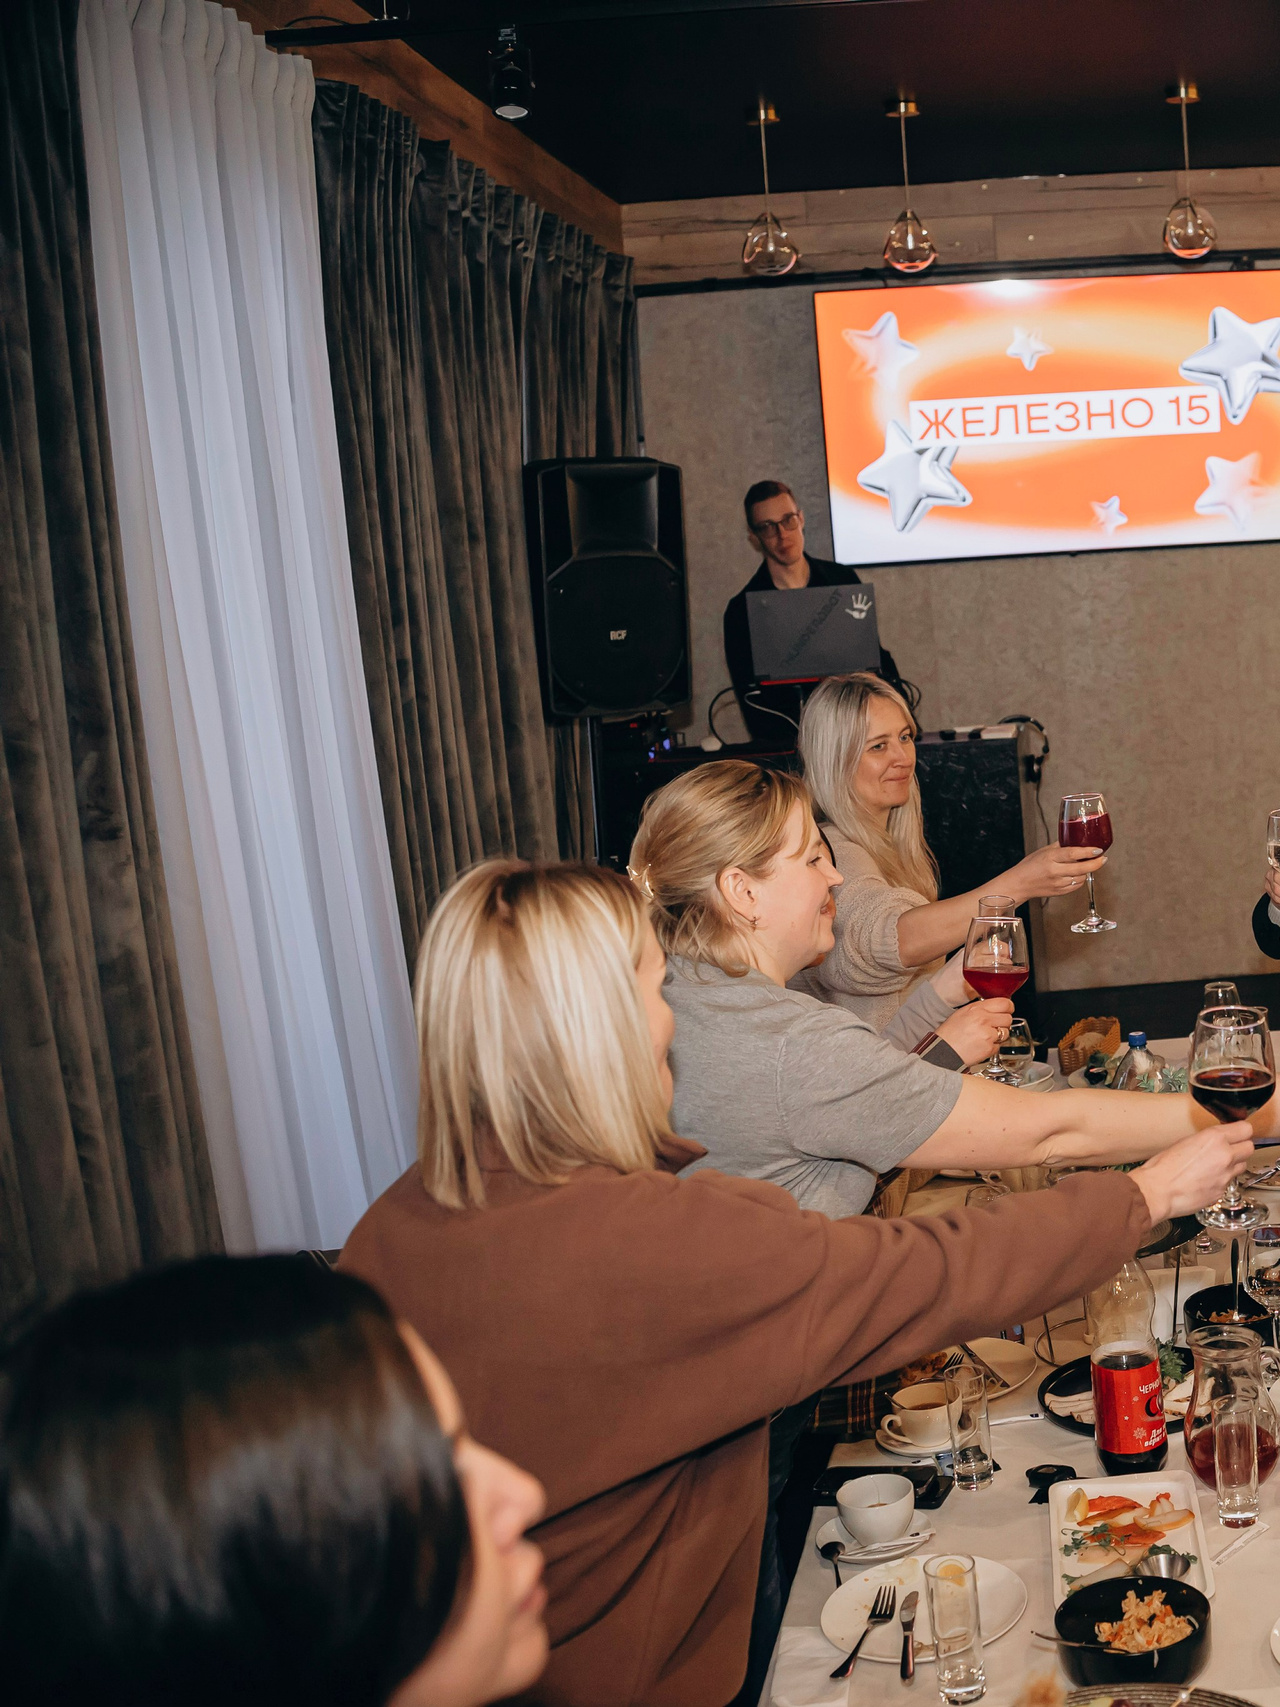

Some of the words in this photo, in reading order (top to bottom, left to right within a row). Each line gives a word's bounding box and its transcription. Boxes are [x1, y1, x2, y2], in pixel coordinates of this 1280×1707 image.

[917, 397, 1154, 441] ЖЕЛЕЗНО
[1168, 394, 1211, 427] 15
[610, 629, 627, 641] RCF
